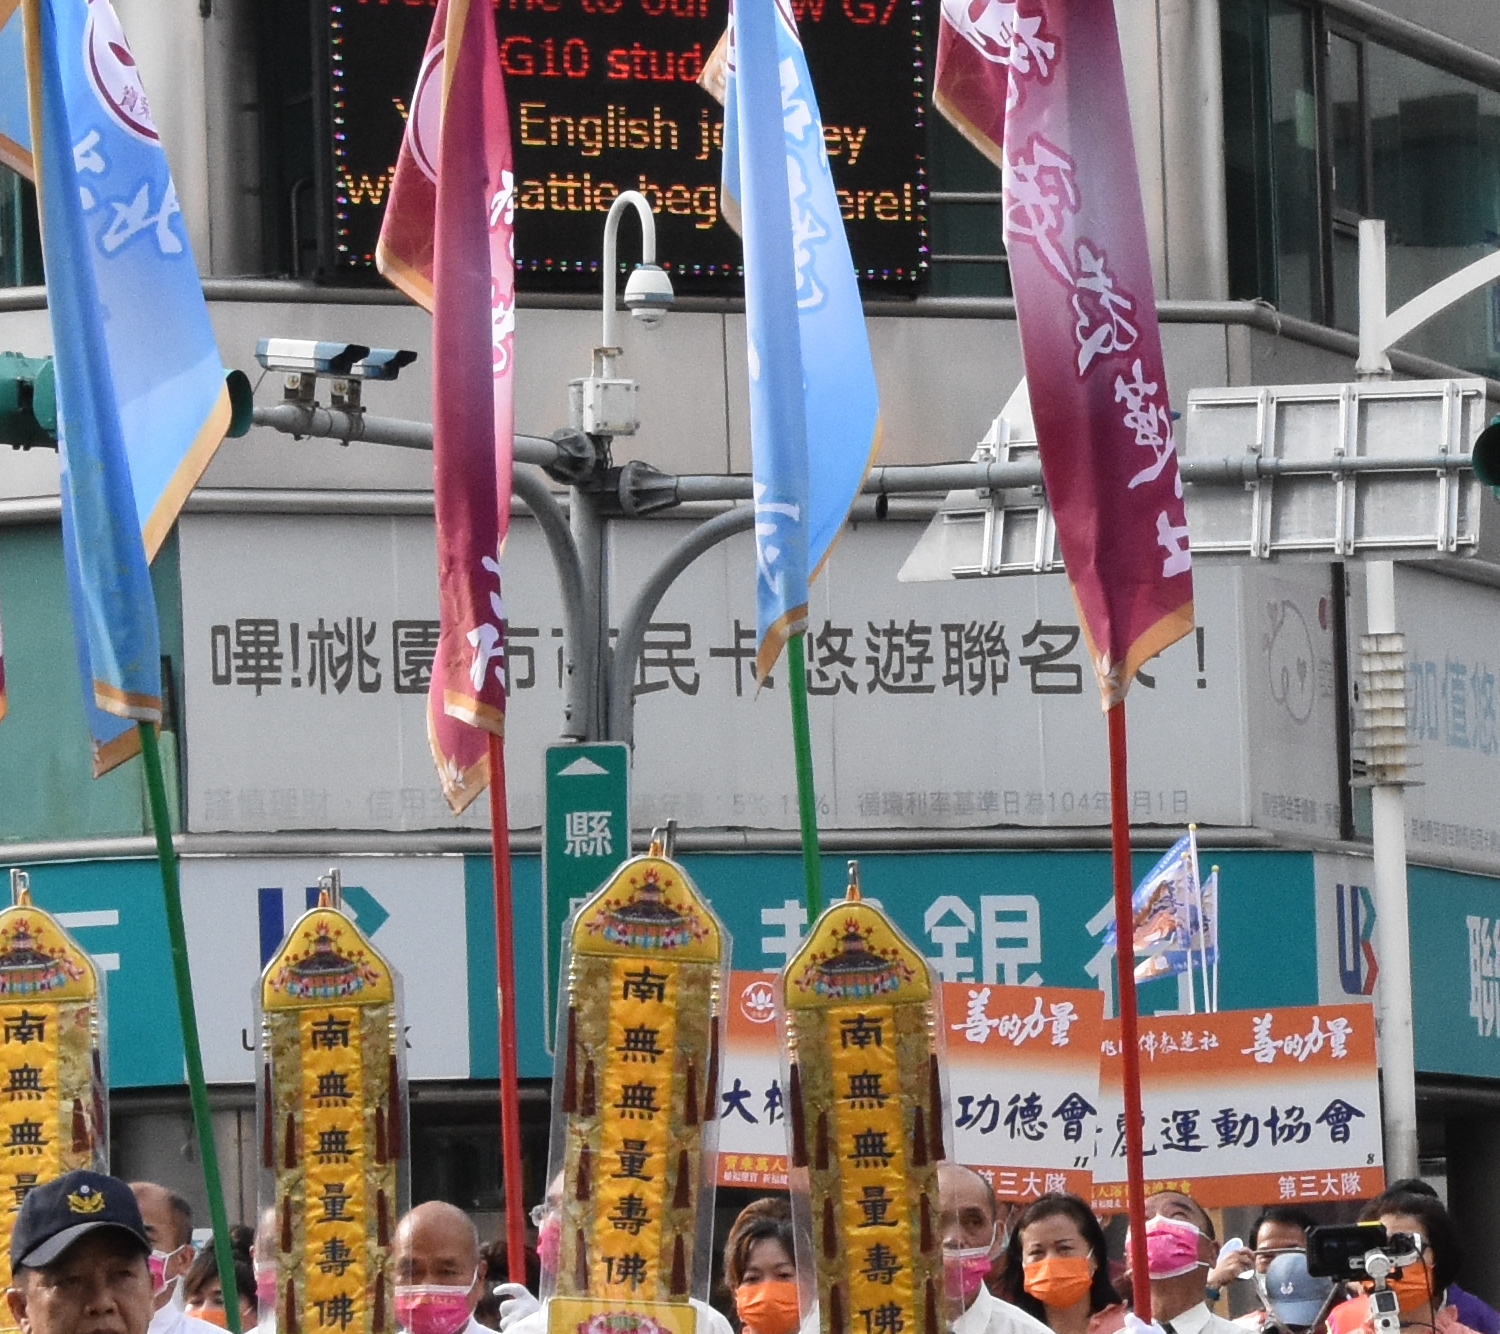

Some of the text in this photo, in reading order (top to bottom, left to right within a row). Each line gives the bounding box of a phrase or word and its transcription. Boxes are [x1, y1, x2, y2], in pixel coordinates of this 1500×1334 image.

[499, 35, 706, 81] G10 stud
[519, 101, 679, 156] English
[210, 616, 1207, 698] 嗶!桃園市民卡悠遊聯名!
[857, 788, 1189, 816] 循環利率基準日為104年月1日
[1240, 1012, 1353, 1064] 善的力量
[601, 965, 670, 1292] 南無無量壽佛
[309, 1013, 357, 1334] 南無無量壽佛
[1277, 1171, 1362, 1200] 第三大隊
